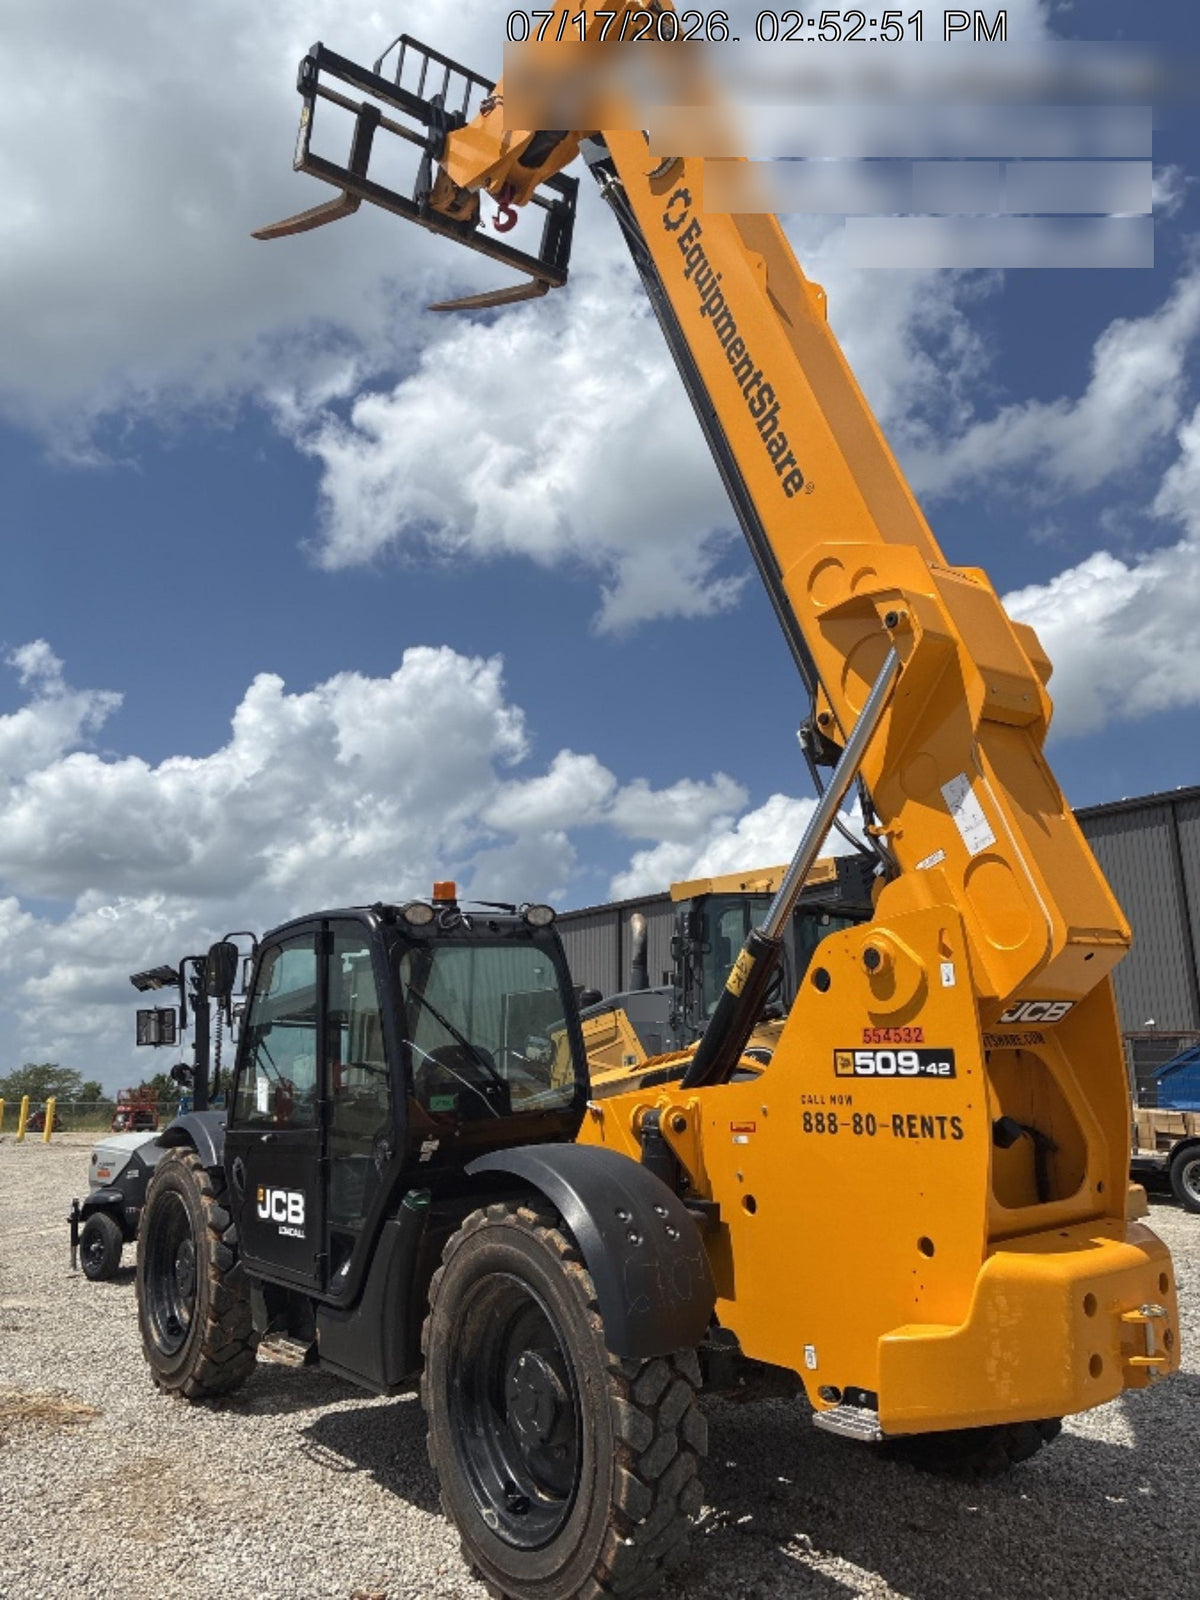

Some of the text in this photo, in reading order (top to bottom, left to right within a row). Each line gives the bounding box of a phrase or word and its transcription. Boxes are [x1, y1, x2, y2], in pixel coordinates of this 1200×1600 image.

[677, 217, 804, 498] EquipmentShare
[1000, 1001, 1074, 1022] JCB
[863, 1027, 923, 1044] 554532
[801, 1095, 853, 1105] CALL NOW
[803, 1111, 964, 1140] 888-80-RENTS
[258, 1188, 305, 1225] JCB
